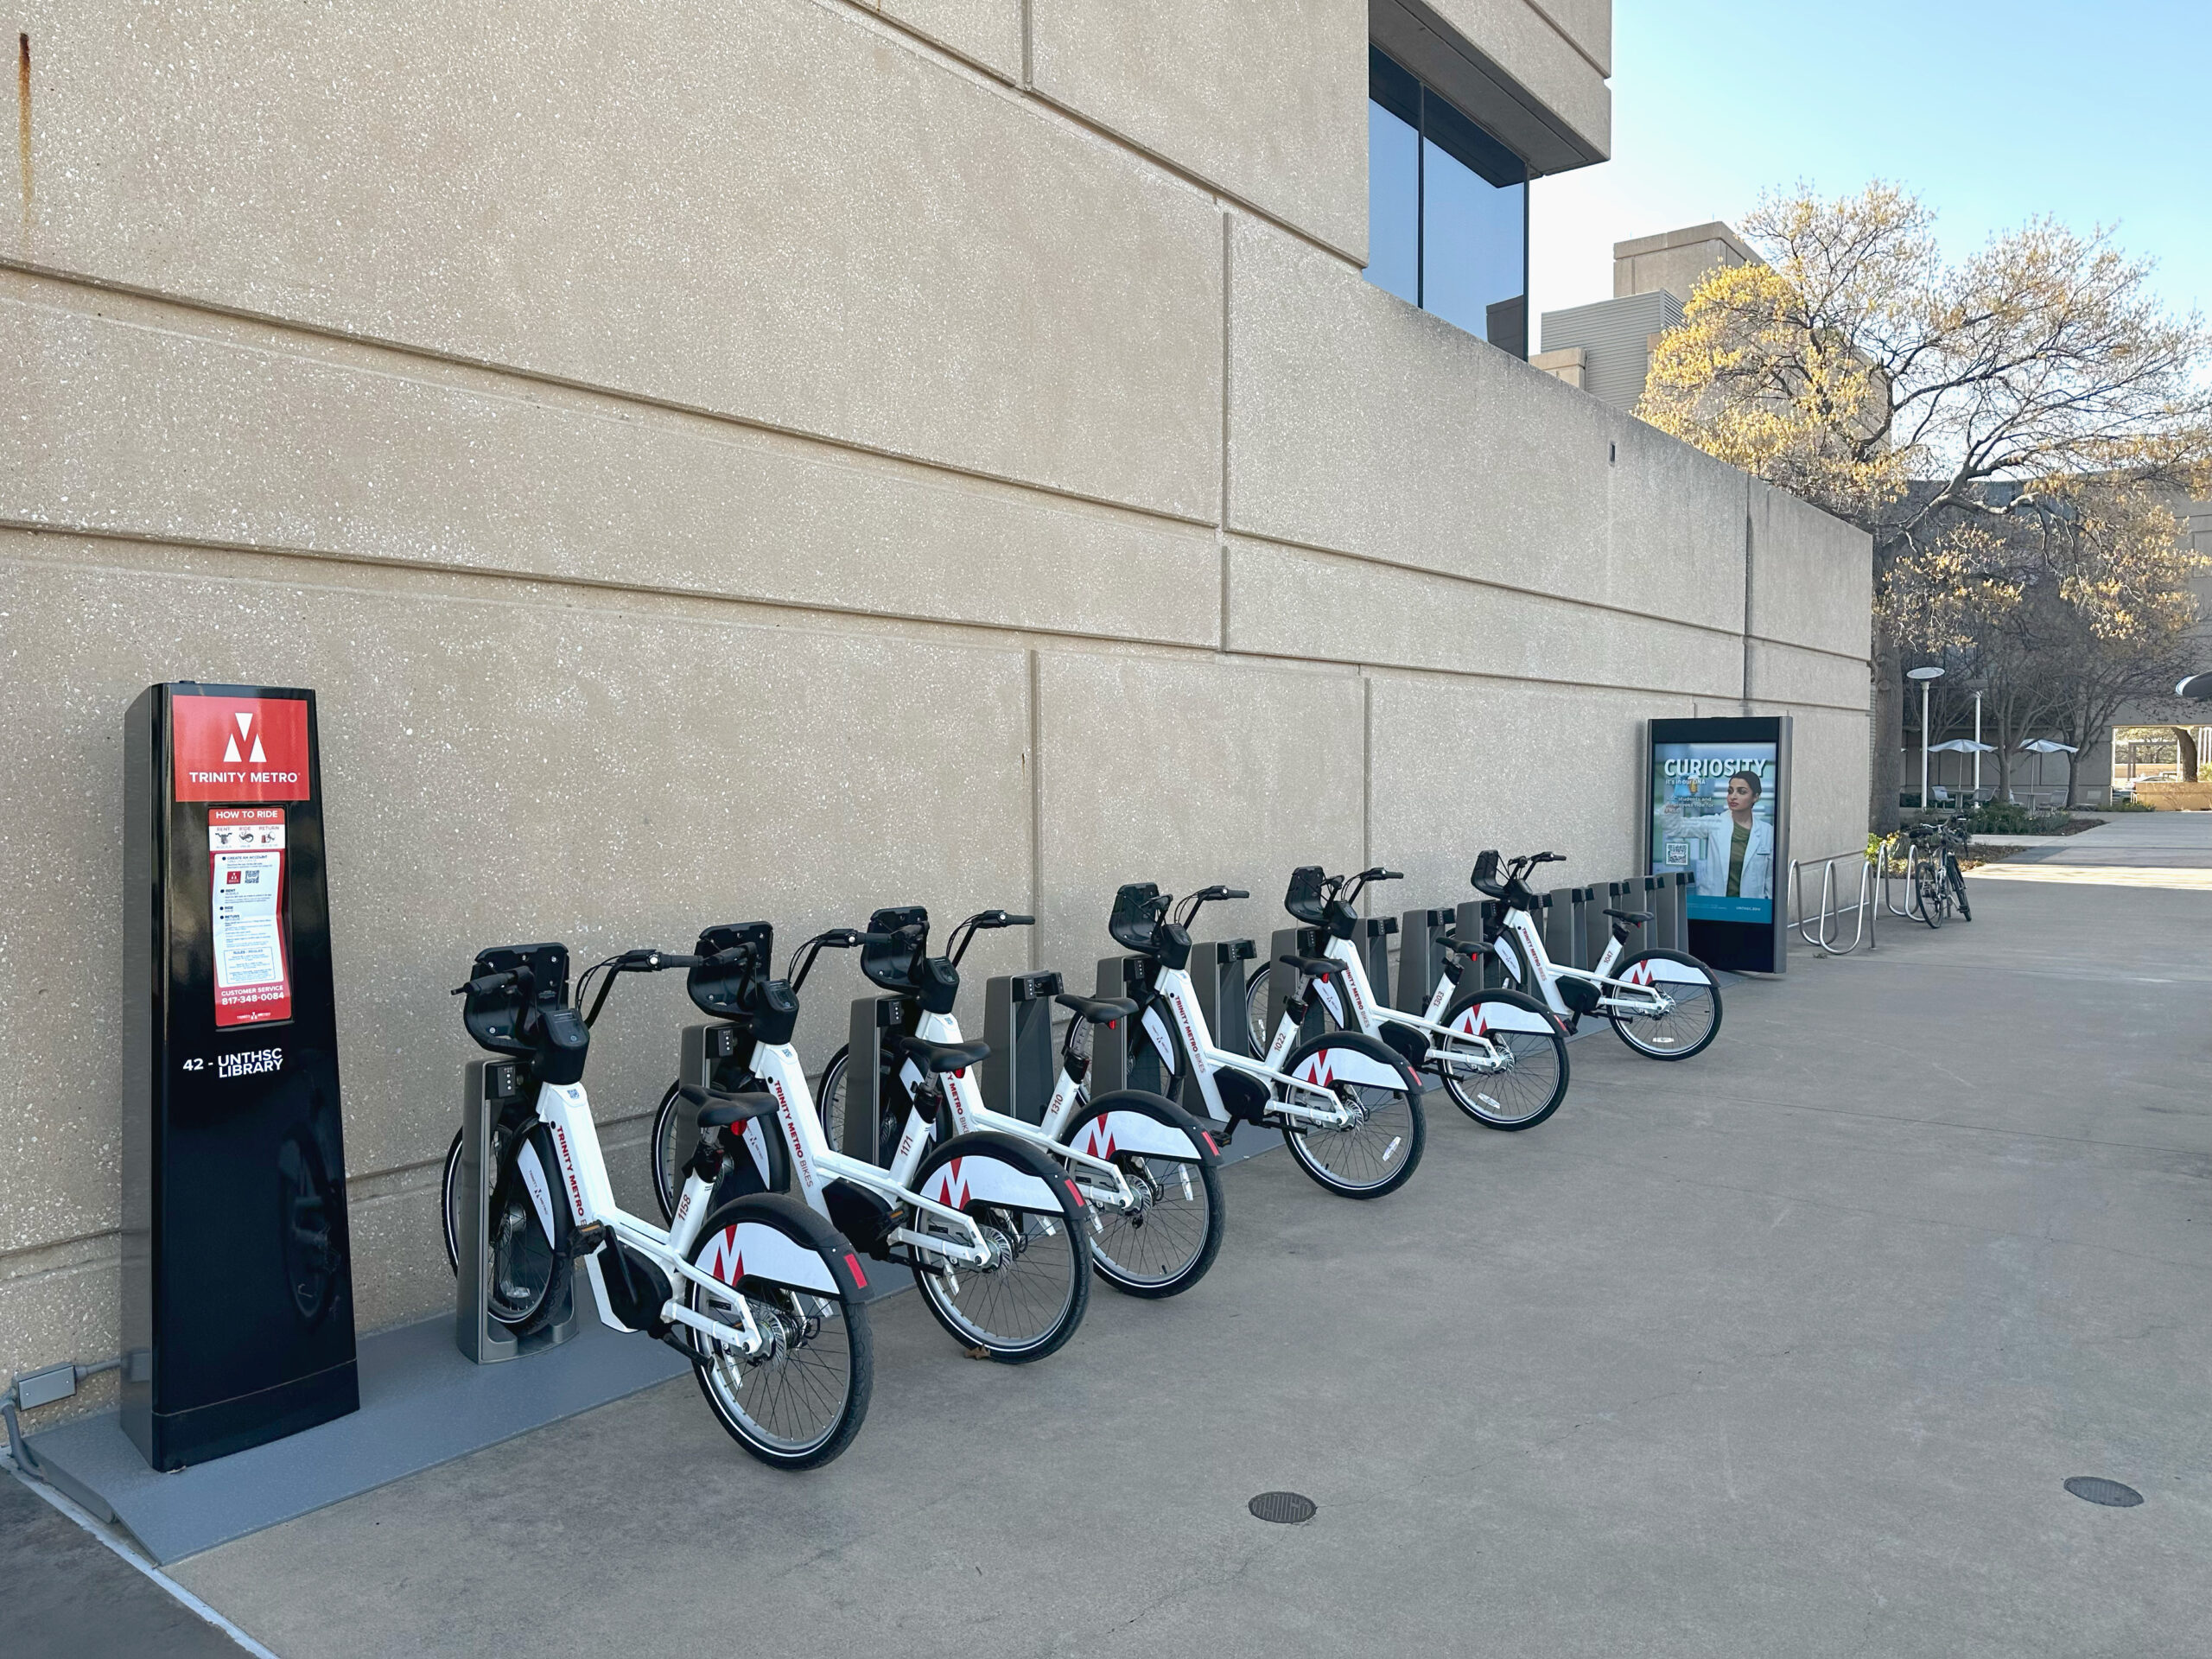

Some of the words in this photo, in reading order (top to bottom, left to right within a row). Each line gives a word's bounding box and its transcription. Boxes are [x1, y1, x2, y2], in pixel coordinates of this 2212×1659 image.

[189, 772, 246, 783] TRINITY
[251, 772, 298, 783] METRO
[1663, 759, 1766, 777] CURIOSITY
[221, 988, 257, 996] CUSTOMER
[1345, 963, 1356, 987] INITY
[1352, 988, 1363, 1010] METRO
[221, 992, 284, 1006] 817-348-0084
[1433, 990, 1444, 1007] 1303
[1175, 995, 1189, 1026] TRINITY
[1185, 1027, 1198, 1052] METRO
[1194, 1053, 1206, 1074] BIKES
[1274, 1033, 1286, 1052] 1022
[182, 1058, 204, 1071] 42
[218, 1047, 283, 1067] UNTHSC
[219, 1058, 283, 1078] LIBRARY
[949, 1083, 963, 1116] METRO
[959, 1116, 970, 1134] BIKE
[1051, 1094, 1064, 1116] 1310
[773, 1080, 792, 1120] TRINITY
[787, 1122, 804, 1159] METRO
[799, 1160, 813, 1188] BIKES
[900, 1135, 913, 1156] 1171
[556, 1125, 573, 1172] TRINITY
[569, 1174, 585, 1217] METRO
[677, 1194, 691, 1222] 1158
